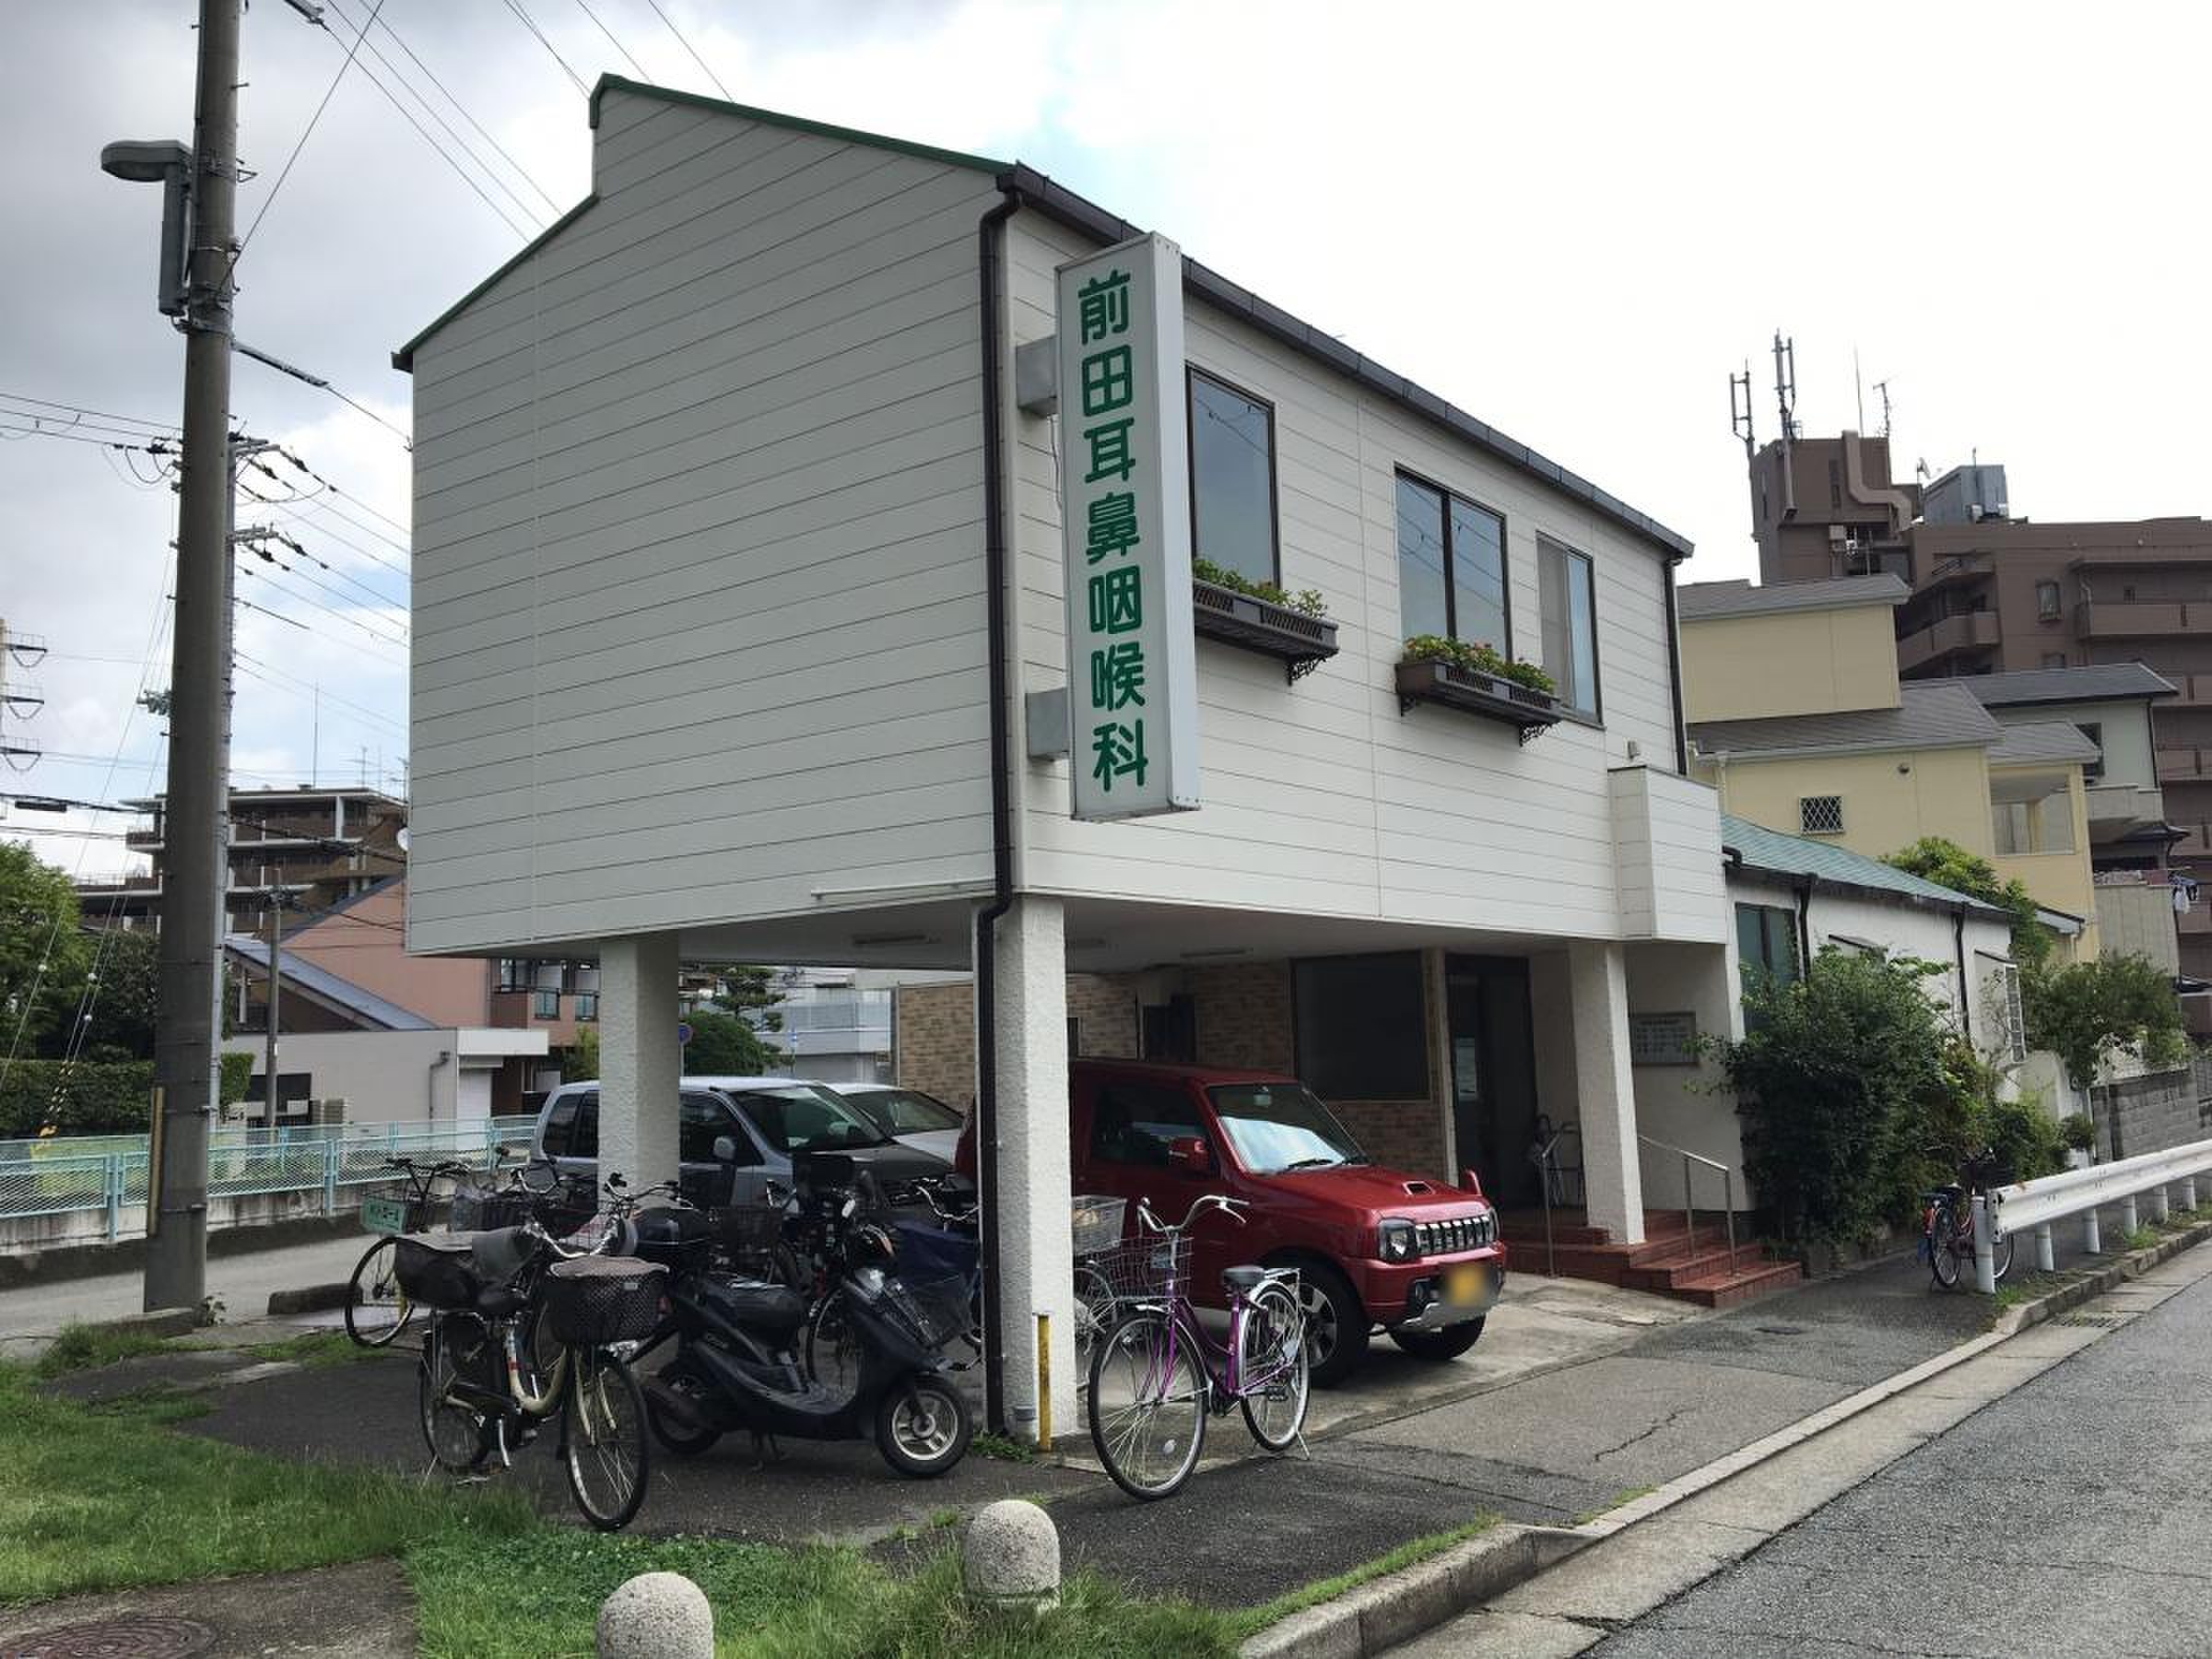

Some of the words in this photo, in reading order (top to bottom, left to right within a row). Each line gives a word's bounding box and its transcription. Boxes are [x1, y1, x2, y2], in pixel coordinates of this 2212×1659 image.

[1078, 269, 1148, 792] 前田耳鼻咽喉科
